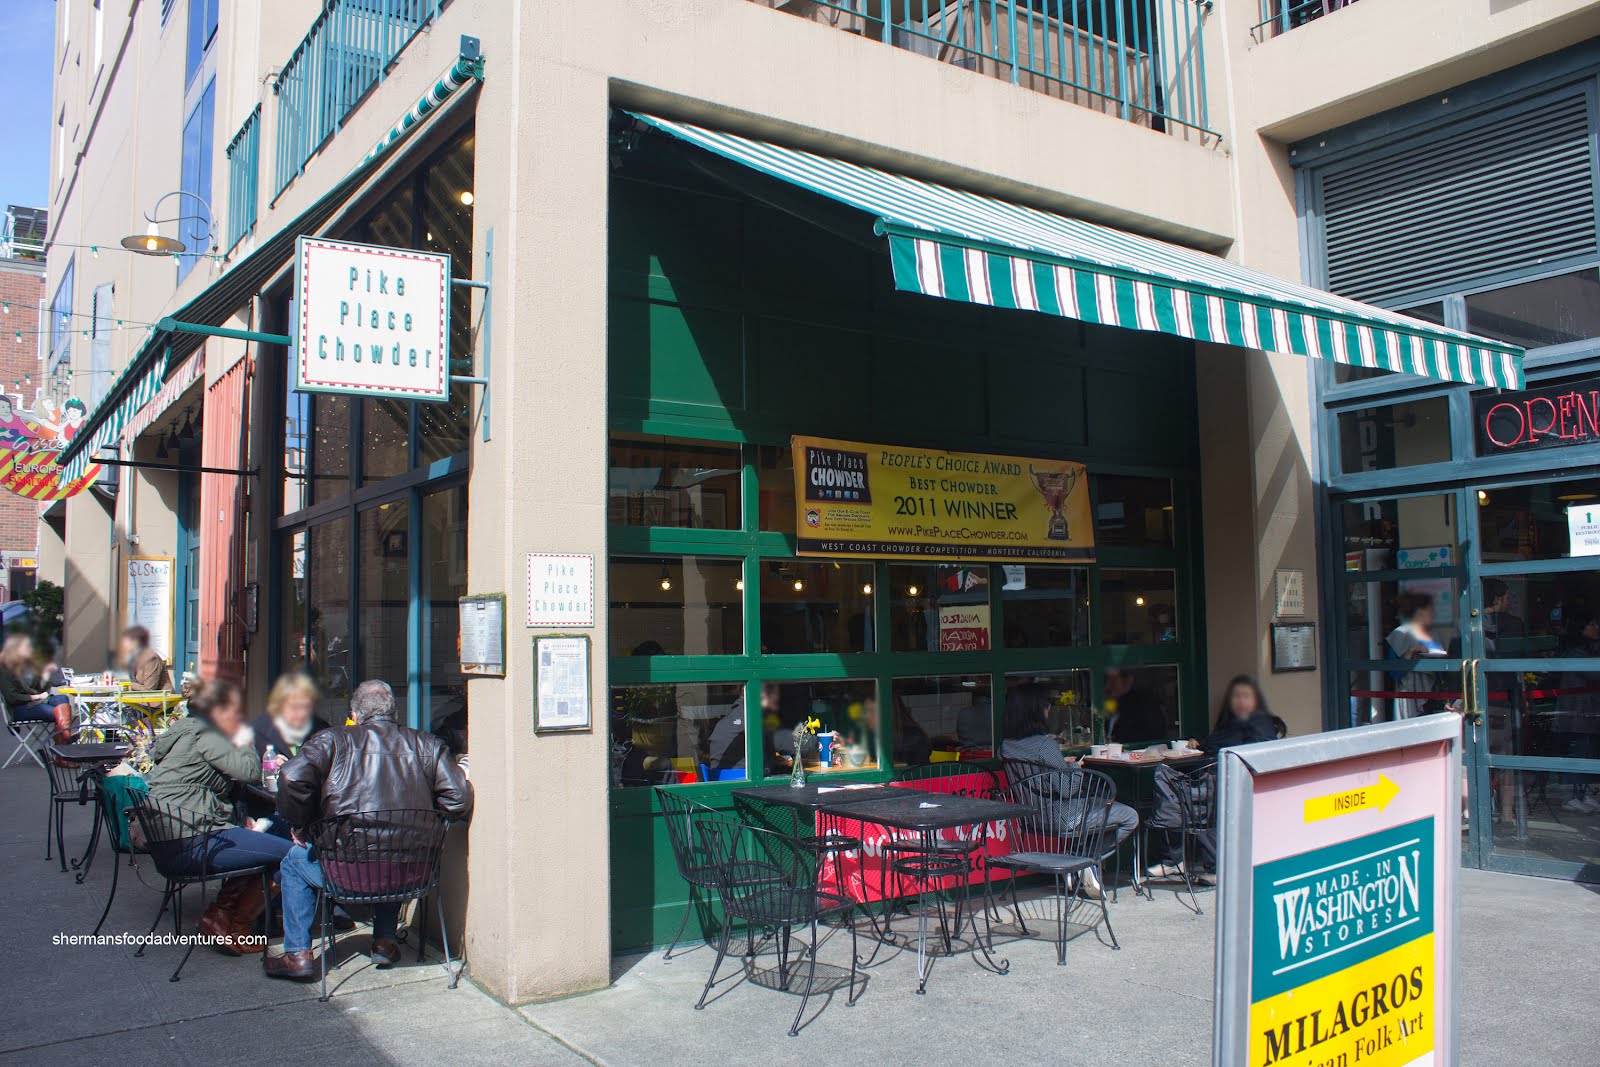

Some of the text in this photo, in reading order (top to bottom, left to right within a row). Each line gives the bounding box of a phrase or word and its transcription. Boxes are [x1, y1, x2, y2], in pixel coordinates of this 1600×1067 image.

[349, 266, 405, 296] Pike
[340, 300, 413, 332] Place
[318, 334, 432, 369] Chowder
[1486, 390, 1600, 447] OPEN
[809, 449, 865, 469] Pike Place
[880, 450, 1022, 477] PEOPLE'S CHOICE AWARD
[810, 466, 866, 490] CHOWDER
[909, 476, 999, 496] BEST CHOWDER
[893, 496, 1019, 521] 2011 WINNER
[821, 542, 844, 552] WEST
[848, 543, 877, 553] COAST
[881, 544, 921, 554] CHOWDER
[925, 545, 978, 555] COMPETITION
[987, 548, 1024, 557] MONTEREY
[1027, 550, 1067, 558] CALIFORNIA
[548, 564, 575, 577] Pike
[544, 581, 579, 595] Place
[535, 599, 588, 613] Chowder
[1334, 792, 1366, 811] INSIDE
[1315, 859, 1391, 897] MADE IN
[1273, 850, 1421, 961] WASHINGTON
[1305, 908, 1392, 954] STORES
[1263, 965, 1424, 1067] MILAGROS
[1354, 1025, 1394, 1063] Folk
[1397, 1011, 1424, 1042] Art
